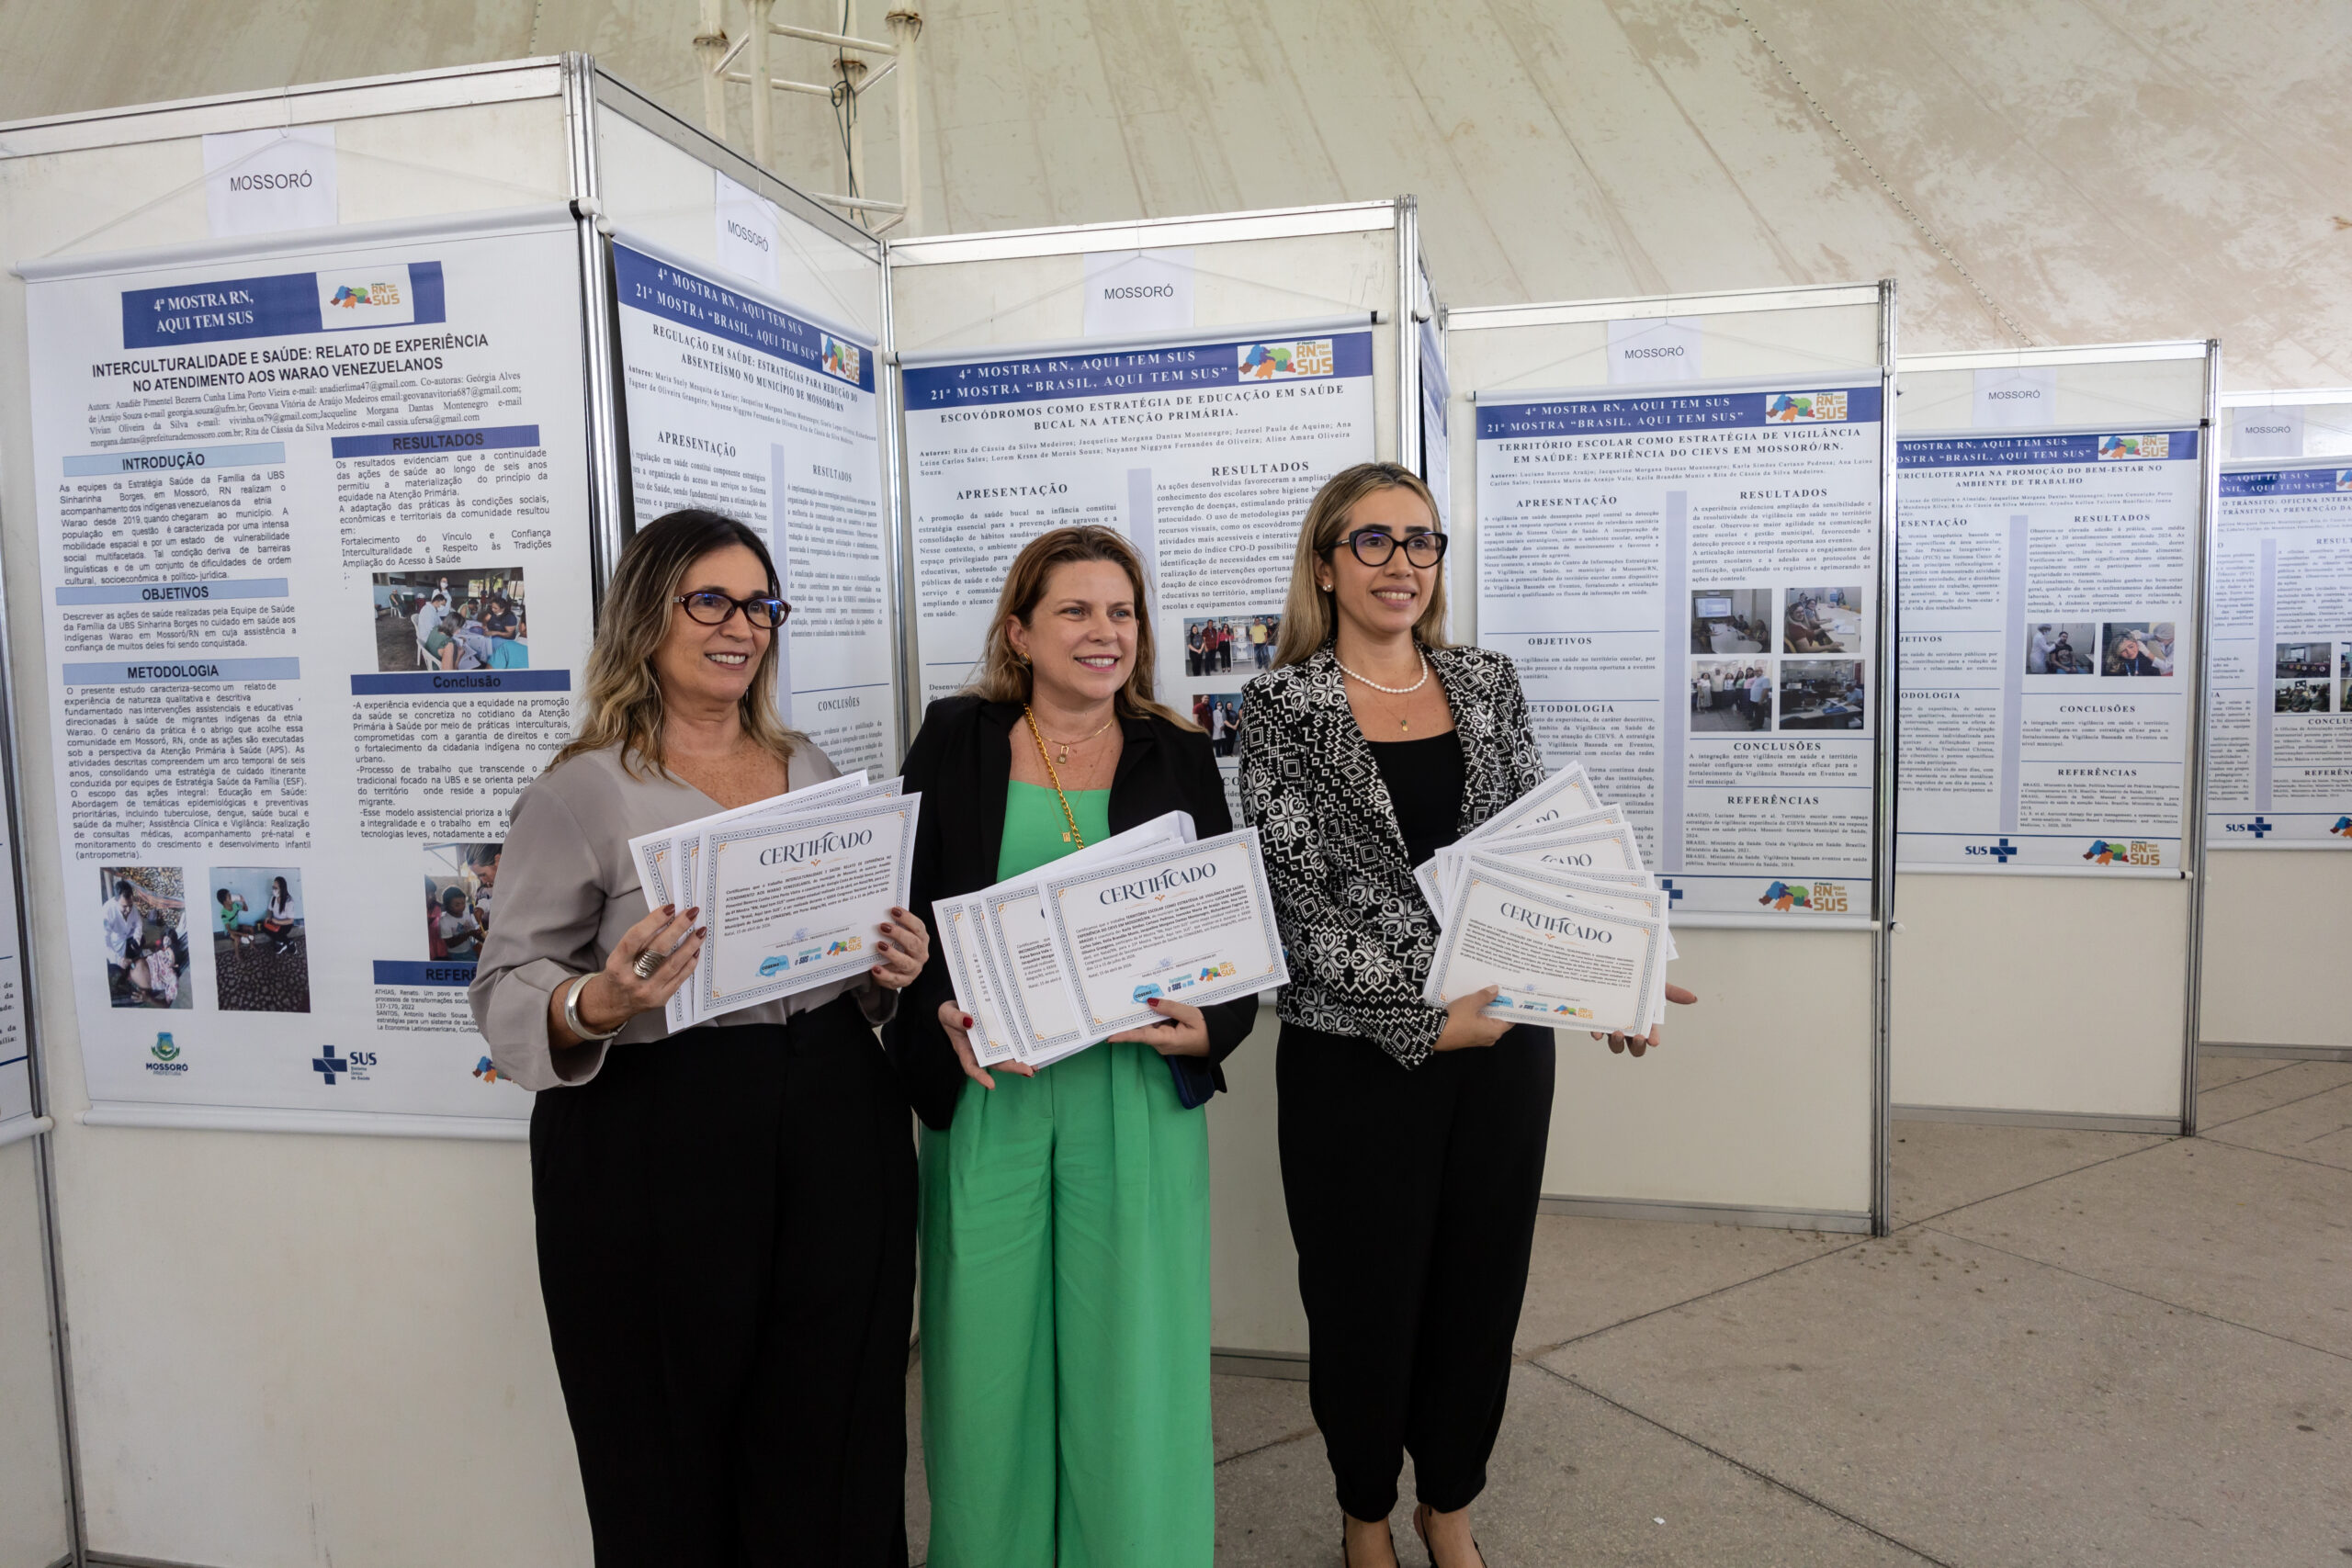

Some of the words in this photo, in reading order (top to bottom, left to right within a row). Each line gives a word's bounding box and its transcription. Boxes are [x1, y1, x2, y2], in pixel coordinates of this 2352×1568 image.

[230, 170, 311, 190] MOSSORÓ
[728, 220, 768, 252] MOSSORÓ
[167, 293, 227, 310] MOSTRA
[228, 289, 254, 304] RN,
[373, 293, 400, 306] SUS
[1104, 284, 1173, 299] MOSSORÓ
[672, 273, 718, 301] MOSTRA
[720, 292, 739, 310] RN,
[741, 302, 764, 320] AQUI
[766, 310, 786, 329] TEM
[787, 320, 802, 335] SUS
[156, 316, 190, 333] AQUI
[192, 313, 224, 328] TEM
[227, 310, 254, 325] SUS
[656, 291, 704, 319] MOSTRA
[756, 329, 777, 346] AQUI
[780, 337, 797, 354] TEM
[92, 352, 247, 377] INTERCULTURALIDADE
[250, 351, 259, 364] E
[262, 346, 311, 363] SAÚDE:
[315, 343, 369, 358] RELATO
[373, 341, 391, 355] DE
[395, 333, 488, 352] EXPERIÊNCIA
[1624, 345, 1684, 358] MOSSORÓ
[652, 323, 708, 351] REGULAÇÃO
[711, 343, 724, 356] EM
[727, 348, 754, 367] SAÚDE:
[757, 358, 804, 383] ESTRATÉGIAS
[806, 376, 821, 389] PARA
[823, 382, 850, 399] REDUÇÃO
[851, 392, 857, 402] DO
[978, 364, 1041, 378] MOSTRA
[1080, 356, 1119, 370] AQUI
[1125, 354, 1159, 366] TEM
[1167, 351, 1195, 363] SUS
[1297, 357, 1333, 375] SUS
[132, 379, 151, 391] NO
[153, 372, 244, 389] ATENDIMENTO
[247, 369, 275, 383] AOS
[277, 365, 329, 380] WARAO
[331, 356, 443, 376] VENEZUELANOS
[956, 384, 1020, 397] MOSTRA
[1103, 373, 1142, 387] AQUI
[1149, 370, 1183, 382] TEM
[1988, 389, 2041, 400] MOSSORÓ
[940, 407, 1042, 423] ESCOVÓDROMOS
[1046, 403, 1084, 414] COMO
[1090, 397, 1170, 411] ESTRATÉGIA
[1176, 396, 1192, 405] DE
[1198, 389, 1270, 403] EDUCAÇÃO
[1275, 388, 1294, 398] EM
[1300, 384, 1343, 396] SAÚDE
[1542, 404, 1597, 414] MOSTRA
[1631, 400, 1664, 412] AQUI
[1670, 399, 1699, 409] TEM
[1705, 398, 1730, 407] SUS
[1034, 419, 1075, 430] BUCAL
[1080, 418, 1096, 426] NA
[1102, 412, 1162, 424] ATENÇÃO
[1168, 407, 1238, 420] PRIMÁRIA.
[1816, 406, 1847, 420] SUS
[1510, 421, 1565, 431] MOSTRA
[1636, 415, 1670, 426] AQUI
[1677, 413, 1705, 423] TEM
[2245, 425, 2292, 434] MOSSORÓ
[393, 433, 484, 450] RESULTADOS
[657, 431, 736, 457] APRESENTAÇÃO
[1498, 440, 1572, 451] TERRITÓRIO
[1577, 438, 1632, 447] ESCOLAR
[1637, 436, 1673, 445] COMO
[1679, 432, 1757, 443] ESTRATÉGIA
[1783, 427, 1860, 438] VIGILÂNCIA
[1904, 443, 1951, 451] MOSTRA
[1981, 440, 2011, 448] AQUI
[121, 451, 205, 469] INTRODUÇÃO
[1513, 455, 1529, 463] EM
[1534, 452, 1577, 462] SAÚDE:
[1582, 448, 1665, 460] EXPERIÊNCIA
[1670, 448, 1686, 457] DO
[1691, 447, 1727, 456] CIEVS
[1734, 446, 1750, 454] EM
[1756, 441, 1843, 453] MOSSORÓ/RN.
[812, 464, 852, 482] RESULTADOS
[1211, 461, 1308, 476] RESULTADOS
[2006, 467, 2064, 476] PROMOÇÃO
[2085, 465, 2143, 473] BEM-ESTAR
[956, 482, 1067, 500] APRESENTAÇÃO
[1740, 489, 1826, 499] RESULTADOS
[1516, 494, 1617, 507] APRESENTAÇÃO
[931, 513, 964, 523] promoção
[984, 510, 1003, 518] saúde
[1085, 503, 1116, 512] constitui
[141, 586, 209, 600] OBJETIVOS
[62, 613, 104, 623] Descrever
[117, 610, 139, 620] ações
[140, 610, 150, 618] de
[152, 608, 173, 617] saúde
[175, 608, 210, 616] realizadas
[212, 607, 228, 616] pela
[230, 606, 256, 615] Equipe
[258, 605, 269, 616] de
[270, 604, 295, 613] Saúde
[1528, 637, 1591, 645] OBJETIVOS
[127, 664, 219, 678] METODOLOGIA
[432, 674, 501, 688] Conclusão
[818, 695, 860, 711] CONCLUSÕES
[2059, 704, 2135, 712] CONCLUSÕES
[1733, 740, 1821, 750] CONCLUSÕES
[2057, 767, 2137, 776] REFERÊNCIAS
[1727, 794, 1818, 805] REFERÊNCIAS
[2225, 823, 2245, 831] SUS
[75, 851, 141, 860] (antropometria).
[760, 829, 872, 866] CERTIFICADO
[1964, 845, 1987, 855] SUS
[2131, 853, 2160, 865] SUS
[1100, 863, 1216, 905] CERTIFICADO
[1814, 897, 1848, 911] SUS
[1500, 902, 1612, 943] CERTIFICADO
[350, 1051, 378, 1066] SUS
[145, 1063, 189, 1071] MOSSORÓ
